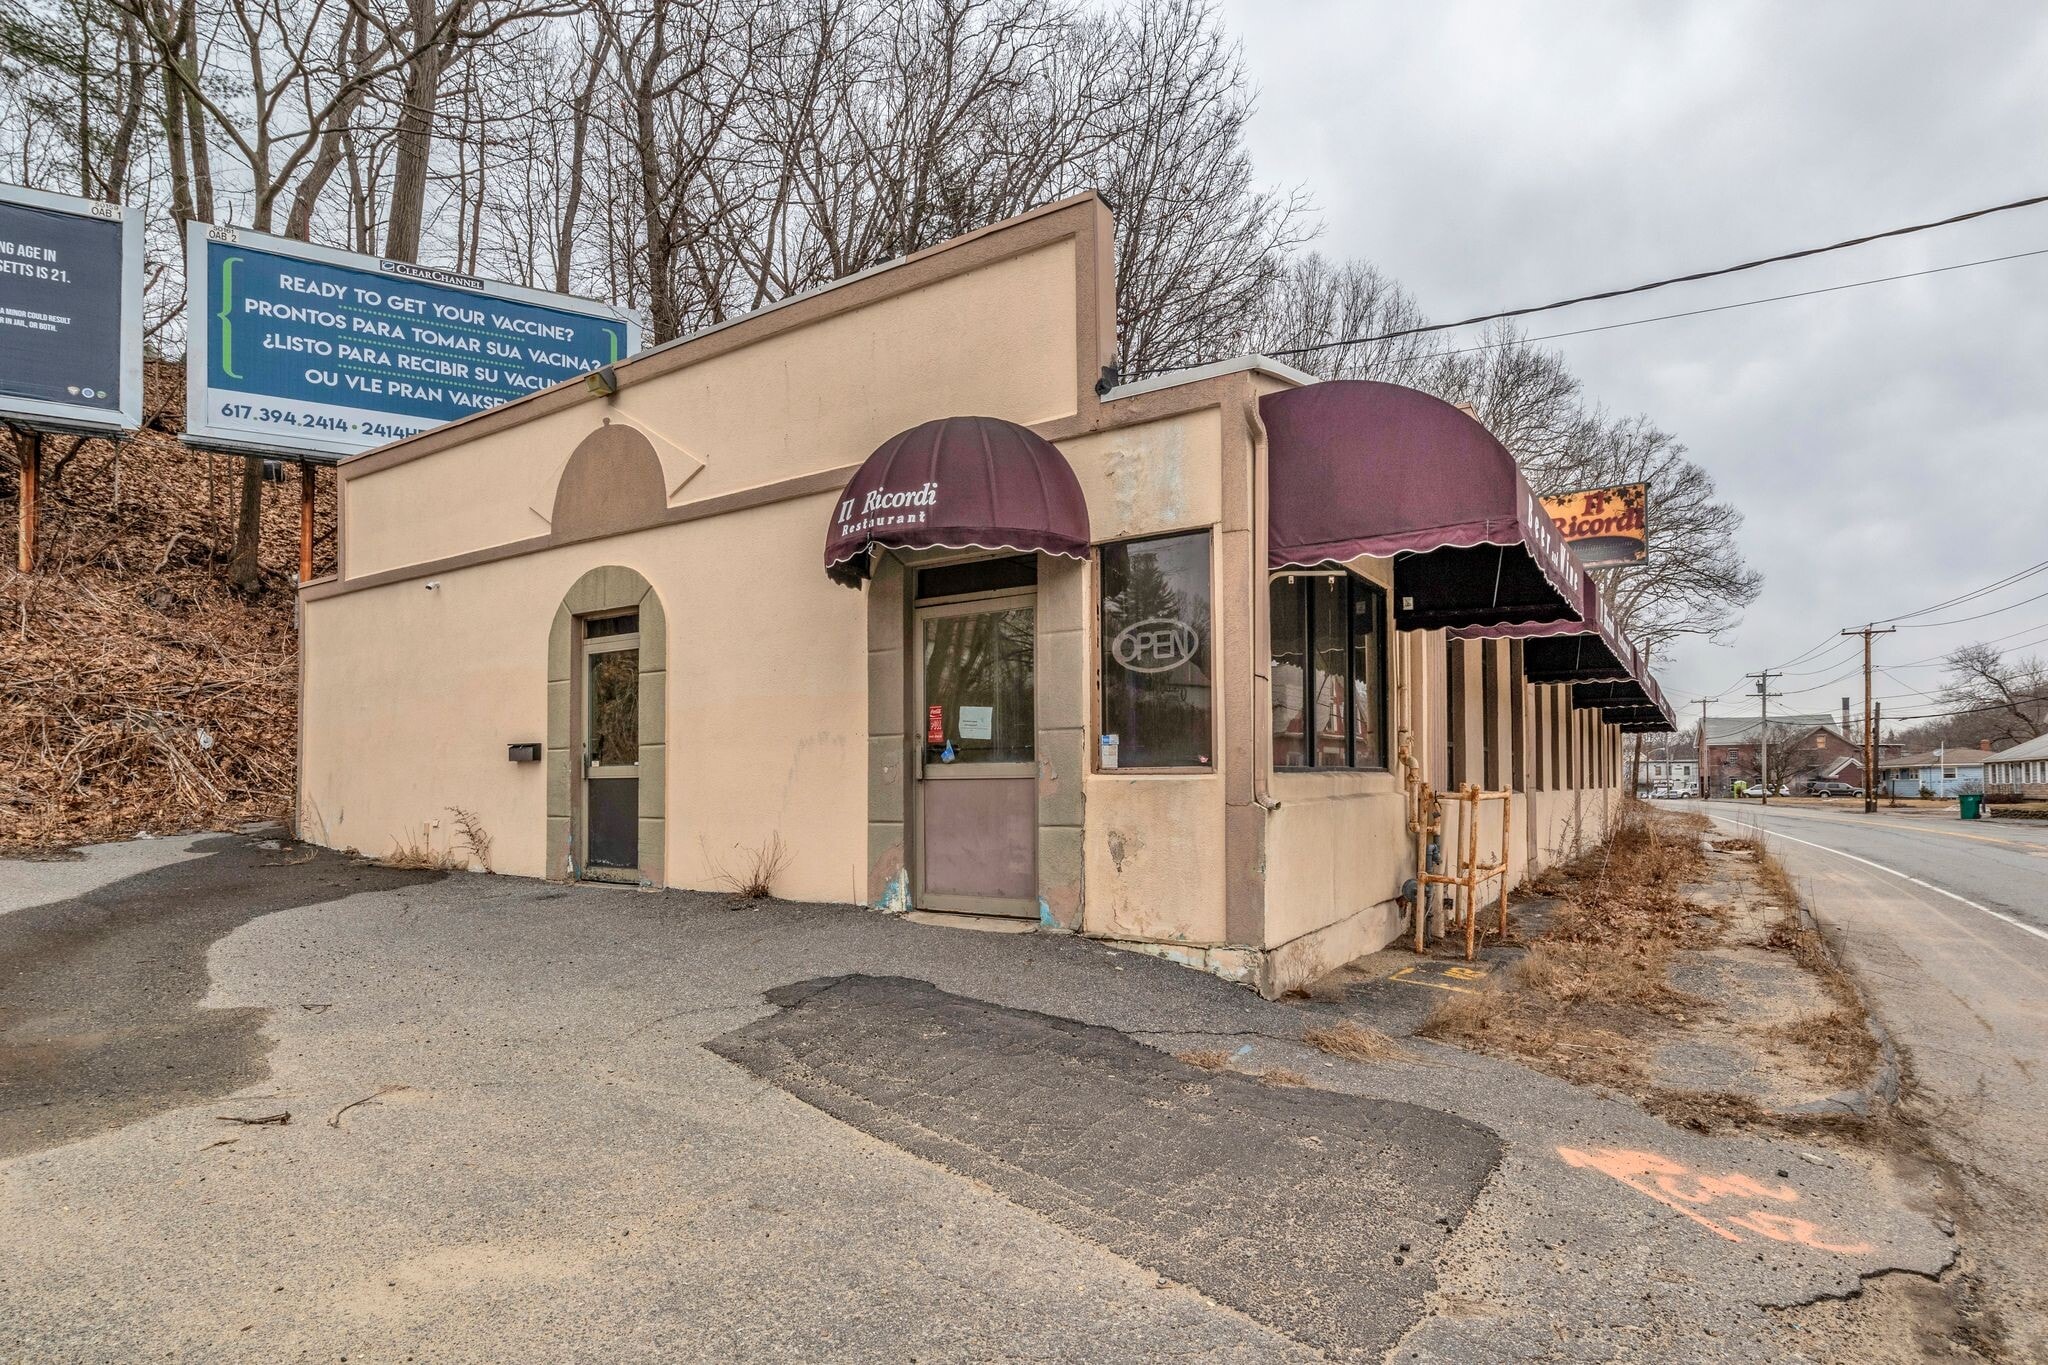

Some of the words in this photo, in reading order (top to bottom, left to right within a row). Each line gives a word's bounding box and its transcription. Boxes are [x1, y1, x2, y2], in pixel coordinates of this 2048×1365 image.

[91, 206, 113, 218] OAB
[208, 229, 227, 241] OAB
[231, 234, 237, 243] 2
[17, 244, 42, 260] AGE
[43, 248, 57, 263] IN
[36, 266, 49, 280] IS
[51, 269, 72, 284] 21.
[5, 308, 27, 318] MINOR
[27, 311, 48, 321] COULD
[48, 315, 71, 325] RESULT
[5, 317, 13, 325] IN
[29, 321, 38, 329] OR
[279, 274, 348, 300] READY
[353, 288, 382, 306] TO
[387, 295, 426, 315] GET
[432, 303, 486, 326] YOUR
[491, 314, 574, 342] VACCINE?
[244, 298, 347, 329] PRONTOS
[352, 317, 406, 340] PARA
[411, 328, 481, 352] TOMAR
[486, 341, 523, 360] SUA
[528, 348, 601, 372] VACINA?
[262, 333, 333, 356] ¿LISTO
[338, 344, 392, 367] PARA
[398, 353, 469, 378] RECIBIR
[474, 367, 498, 383] SU
[304, 369, 339, 387] OU
[344, 374, 383, 394] VLE
[388, 381, 443, 403] PRAN
[448, 390, 509, 410] VAKSE
[221, 403, 348, 432] 617.394.2414
[837, 498, 856, 524] Il
[861, 482, 938, 515] Ricordi
[841, 511, 926, 537] Restaurant
[1551, 507, 1645, 538] Ricordi
[1528, 494, 1551, 555] Beer
[1560, 542, 1578, 591] Wine
[1118, 626, 1189, 663] OPEN
